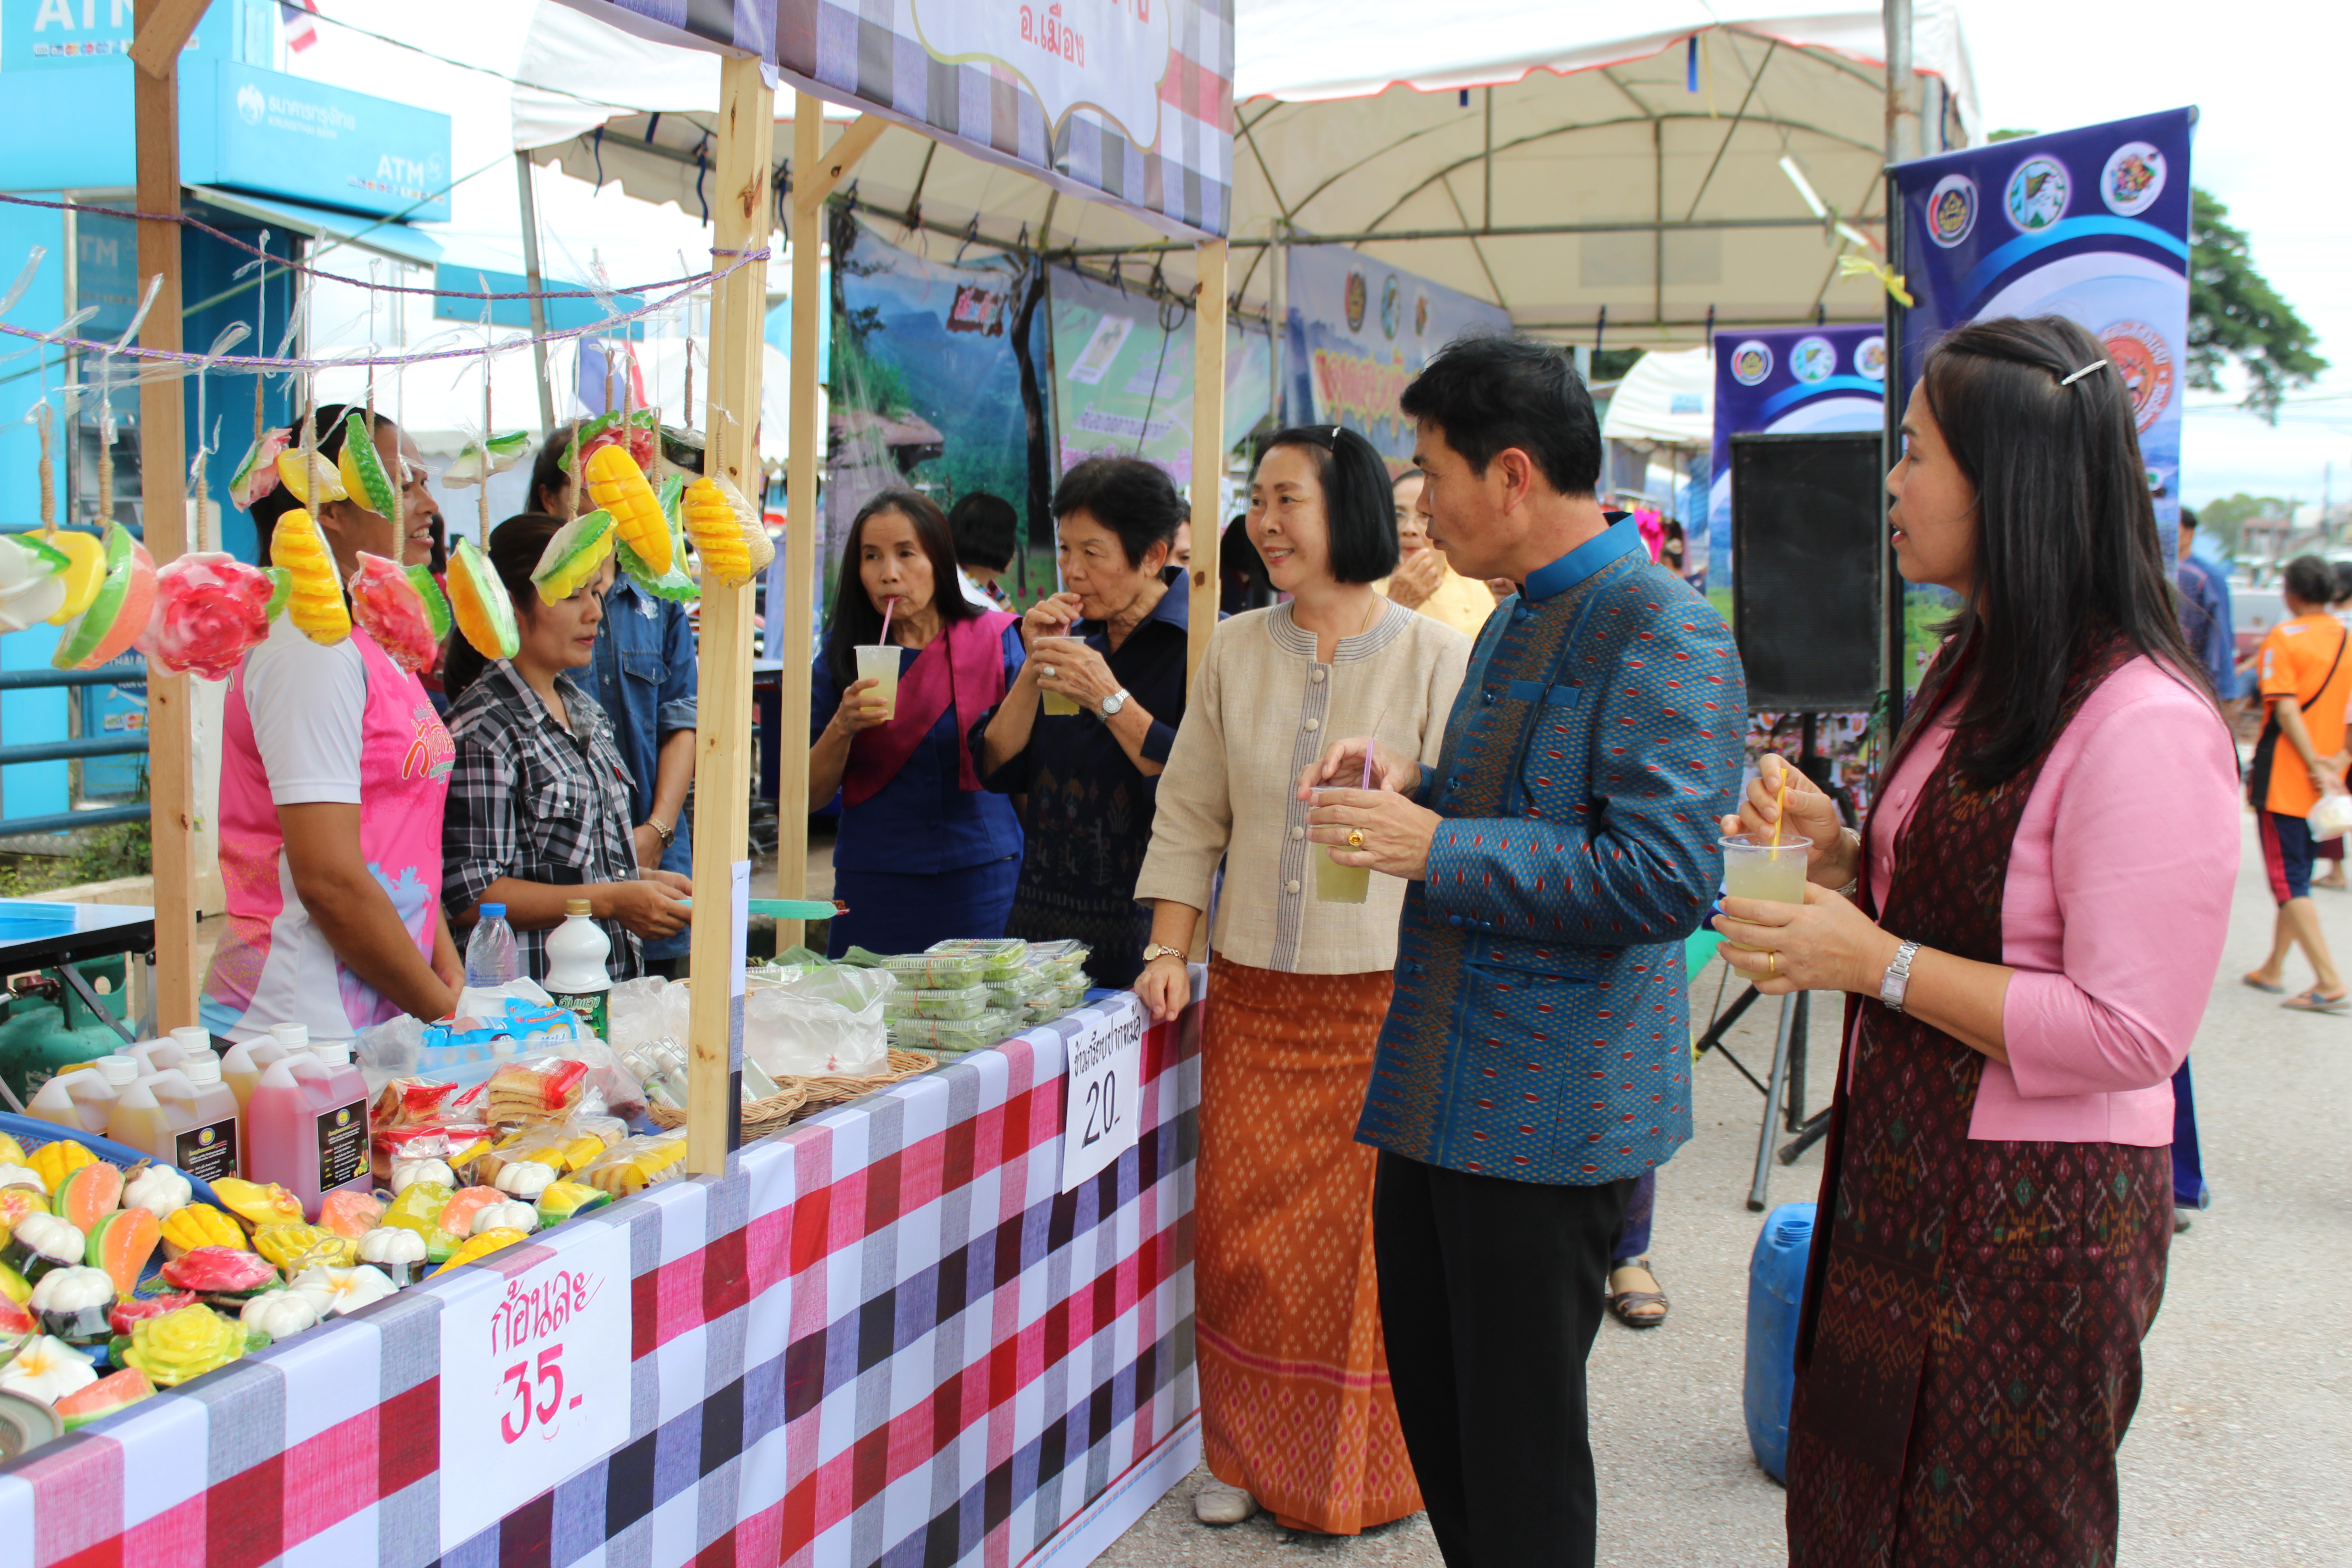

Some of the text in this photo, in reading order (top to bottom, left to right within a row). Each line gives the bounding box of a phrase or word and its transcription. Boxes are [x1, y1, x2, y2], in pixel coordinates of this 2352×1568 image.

[1019, 2, 1084, 69] อ.เมือง
[376, 153, 424, 187] ATM
[78, 234, 118, 267] TM
[490, 1270, 607, 1358] ก้อนละ
